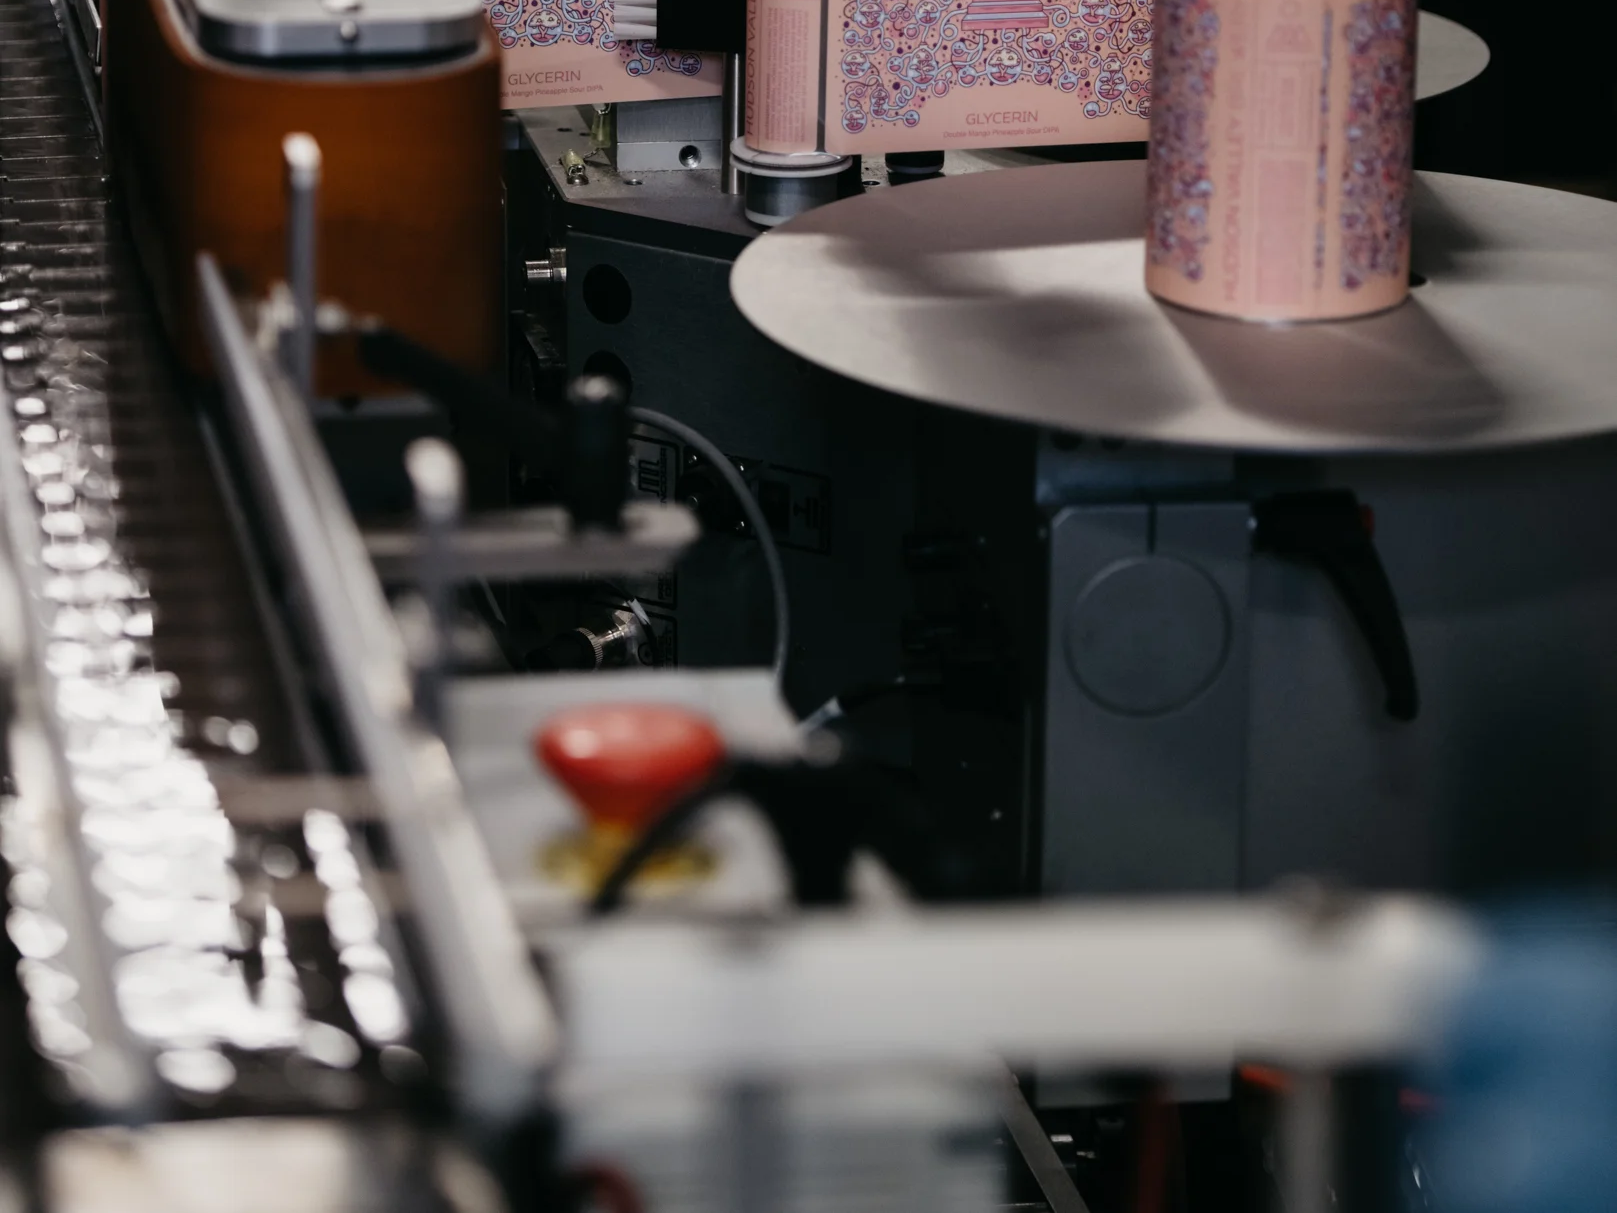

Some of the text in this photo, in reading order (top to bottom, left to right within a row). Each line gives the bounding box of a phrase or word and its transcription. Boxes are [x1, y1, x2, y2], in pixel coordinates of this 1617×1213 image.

[508, 70, 581, 86] GLYCERIN
[511, 89, 534, 98] Mango
[535, 87, 568, 96] Pineapple
[586, 84, 604, 93] DIPA
[745, 47, 755, 136] HUDSON
[965, 110, 1039, 126] GLYCERIN
[943, 130, 967, 139] Double
[968, 129, 991, 138] Mango
[992, 127, 1025, 137] Pineapple
